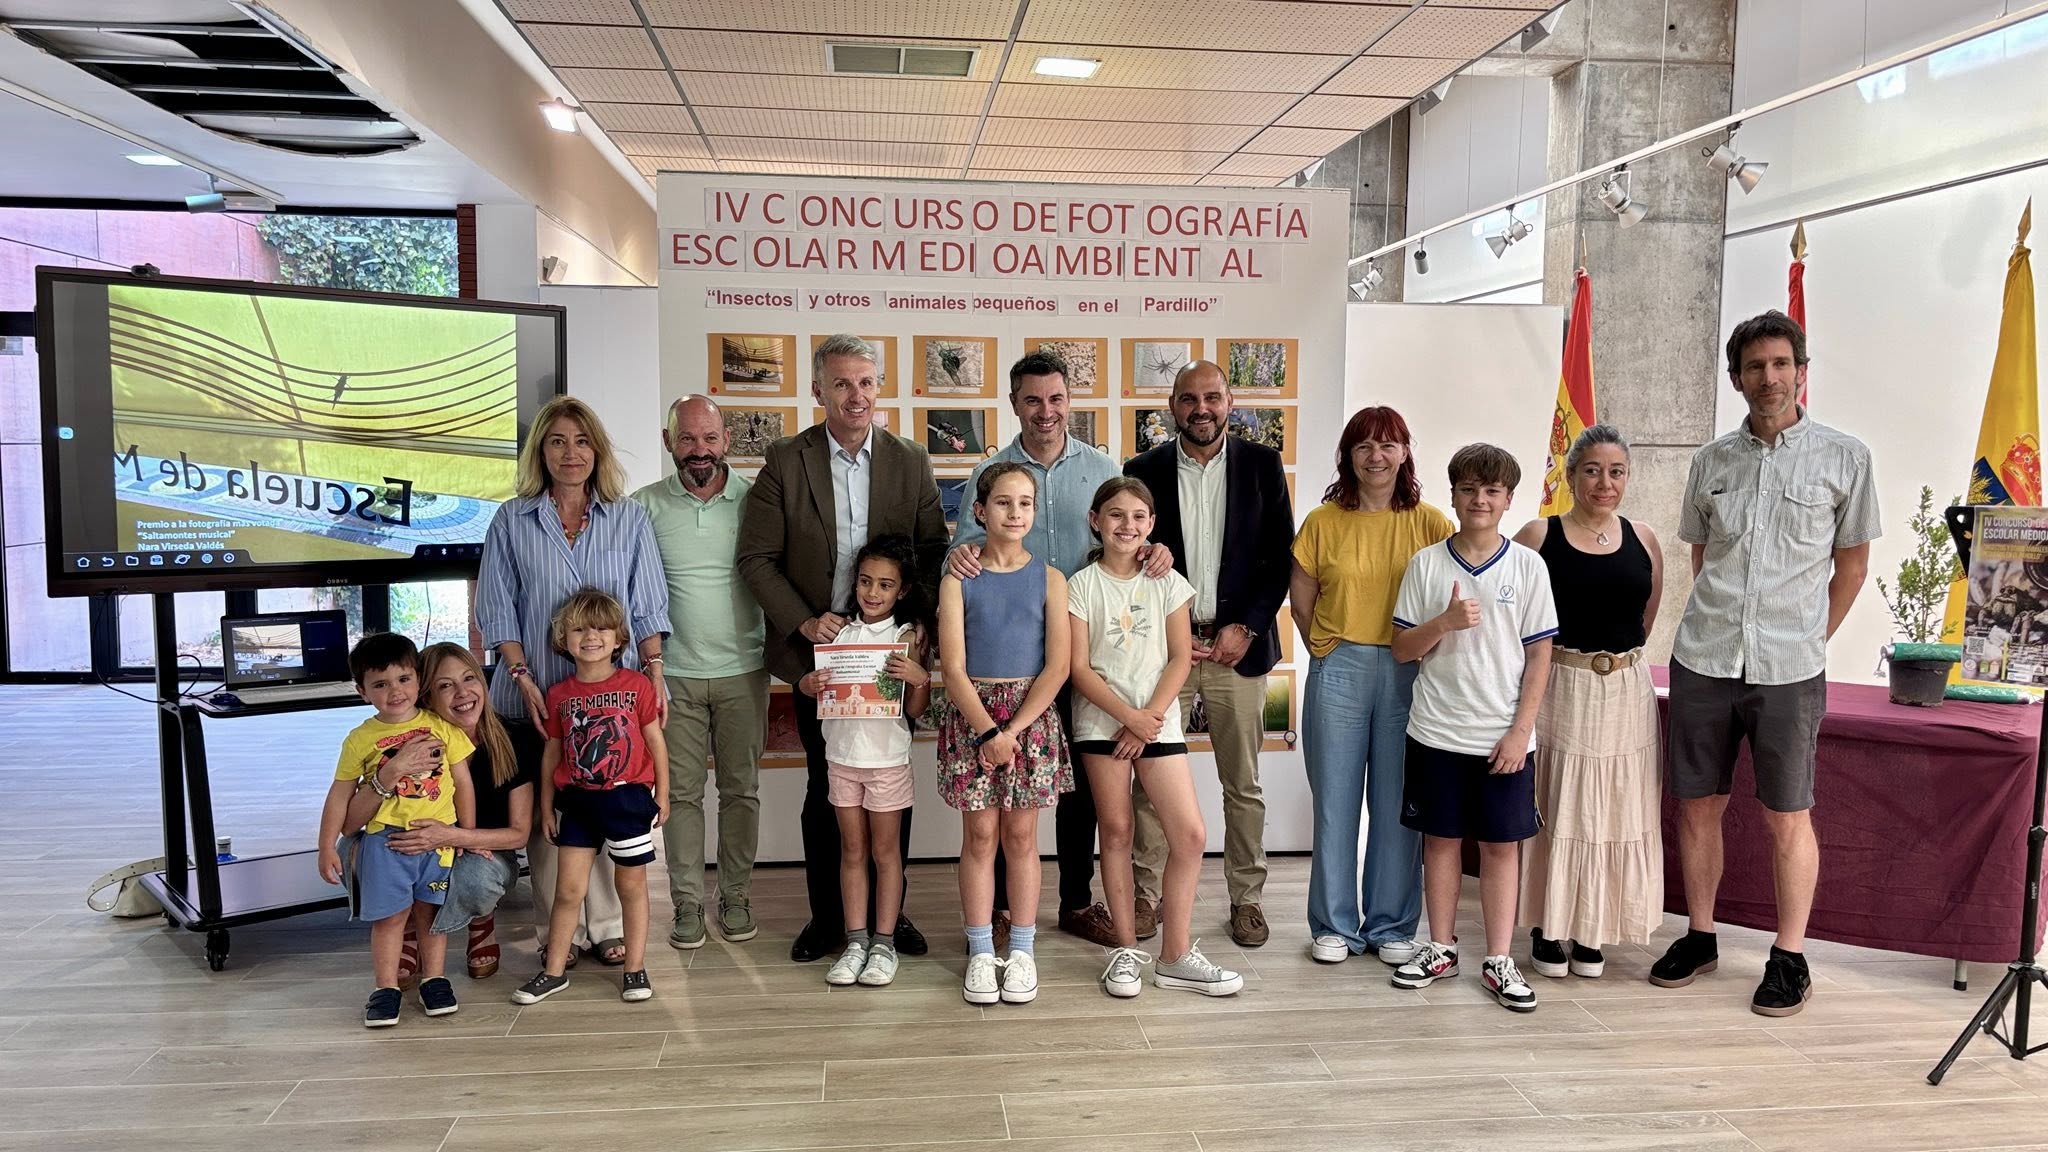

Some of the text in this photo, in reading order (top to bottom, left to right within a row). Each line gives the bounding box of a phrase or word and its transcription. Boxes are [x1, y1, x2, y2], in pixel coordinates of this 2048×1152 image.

[715, 192, 1308, 239] IV CONCURSO DE FOTOGRAFÍA
[672, 234, 1262, 278] ESCOLAR MEDIOAMBIENTAL
[808, 295, 819, 309] y
[824, 294, 871, 308] otros
[888, 295, 967, 311] animales
[973, 297, 1056, 315] pequeños
[1078, 303, 1098, 313] en
[1104, 299, 1119, 313] el
[137, 520, 170, 529] Premio
[179, 520, 187, 528] la
[1984, 516, 1993, 527] IV
[1983, 528, 2020, 540] ESCOLAR
[137, 541, 225, 551] Nara Virseda Valdés
[585, 691, 637, 712] MORALES
